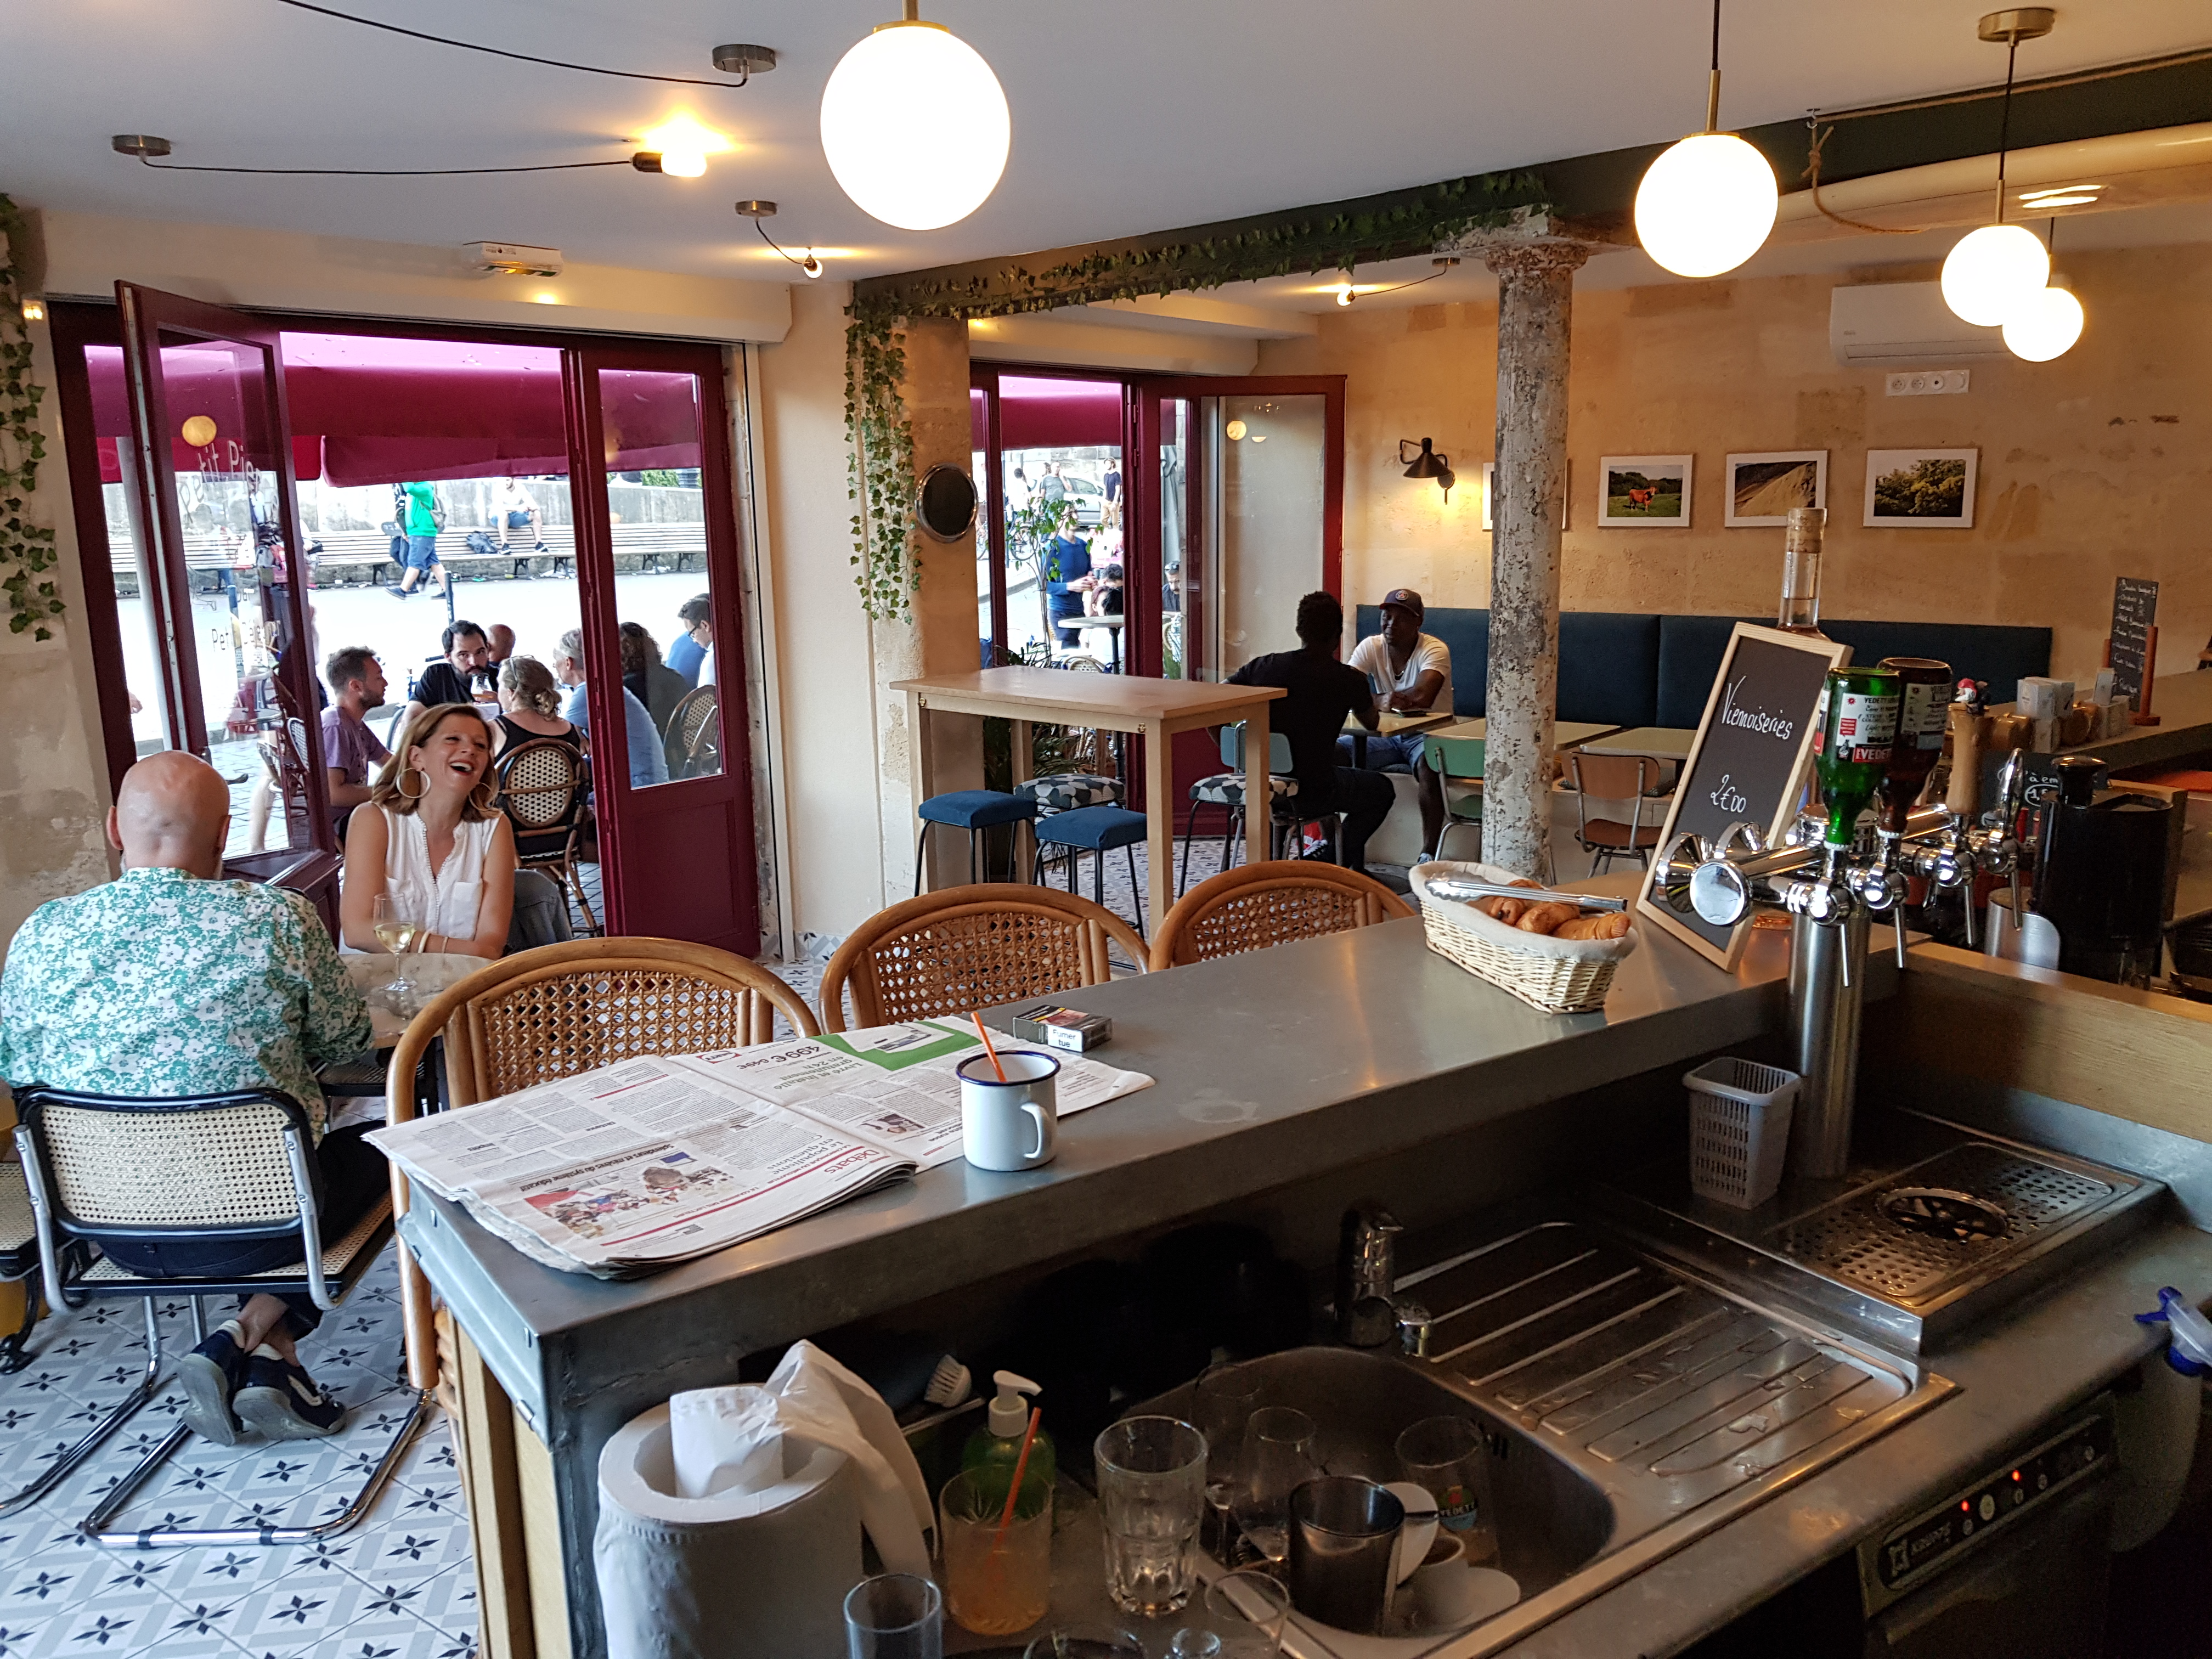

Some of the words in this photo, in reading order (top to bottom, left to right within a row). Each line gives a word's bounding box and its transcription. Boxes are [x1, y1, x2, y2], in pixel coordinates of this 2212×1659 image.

[179, 442, 221, 523] Petit
[1710, 774, 1747, 813] 2€00
[1053, 1029, 1076, 1040] Fumer
[1058, 1039, 1070, 1047] tue
[780, 1059, 853, 1081] gratuitement
[832, 1062, 864, 1074] Livré
[773, 1075, 819, 1090] installé
[635, 1143, 675, 1158] Splendeurs
[767, 1144, 819, 1170] questions
[595, 1156, 625, 1169] misères
[772, 1147, 829, 1175] populisme
[824, 1149, 879, 1173] Débats
[552, 1169, 585, 1181] système
[519, 1178, 552, 1192] éducatif
